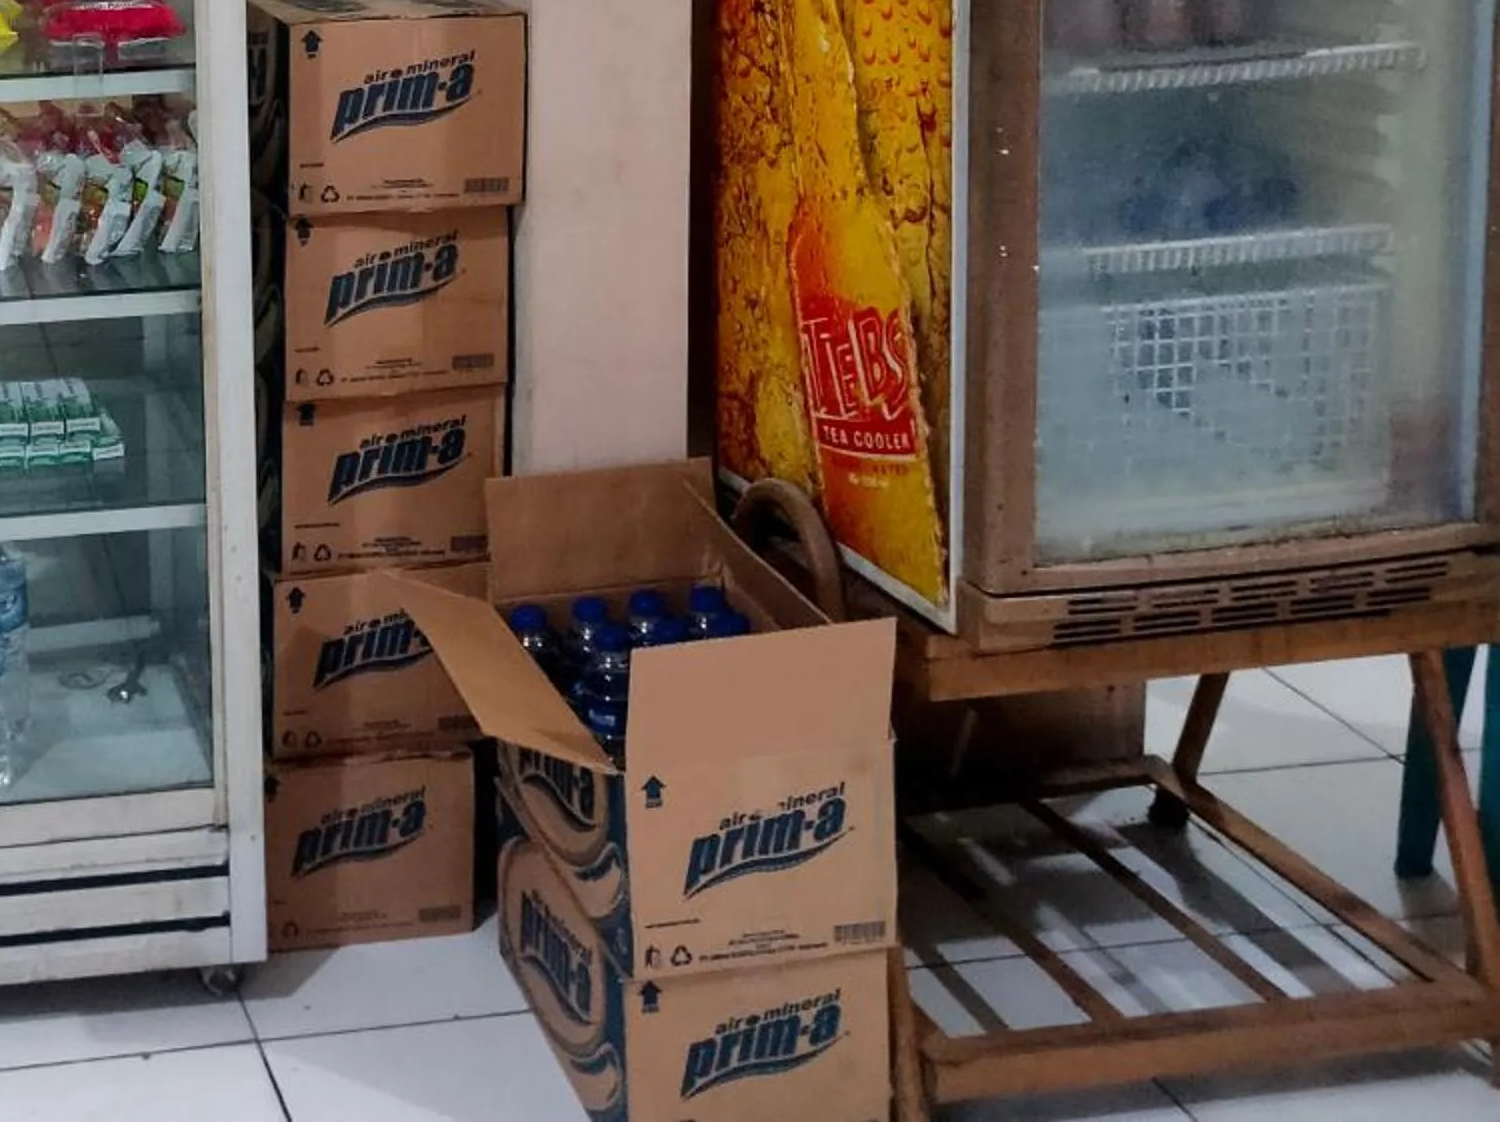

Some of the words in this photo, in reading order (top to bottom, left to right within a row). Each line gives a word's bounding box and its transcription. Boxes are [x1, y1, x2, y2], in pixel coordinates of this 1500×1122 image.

[363, 68, 390, 84] air
[407, 49, 476, 76] mineral
[330, 63, 476, 141] prim-a
[353, 252, 378, 268] air
[393, 230, 460, 257] mineral
[324, 244, 460, 325] prim-a
[801, 307, 907, 420] TEBS
[359, 433, 384, 449] air
[401, 414, 467, 439] mineral
[822, 425, 849, 445] TEA
[853, 430, 911, 451] COOLER
[343, 617, 368, 634] air
[312, 619, 432, 688] prim-
[719, 811, 748, 831] air
[778, 781, 845, 811] ineral
[683, 797, 846, 895] prim-a
[714, 1015, 743, 1034] air
[764, 988, 842, 1022] mineral
[680, 1003, 842, 1098] prim-a
